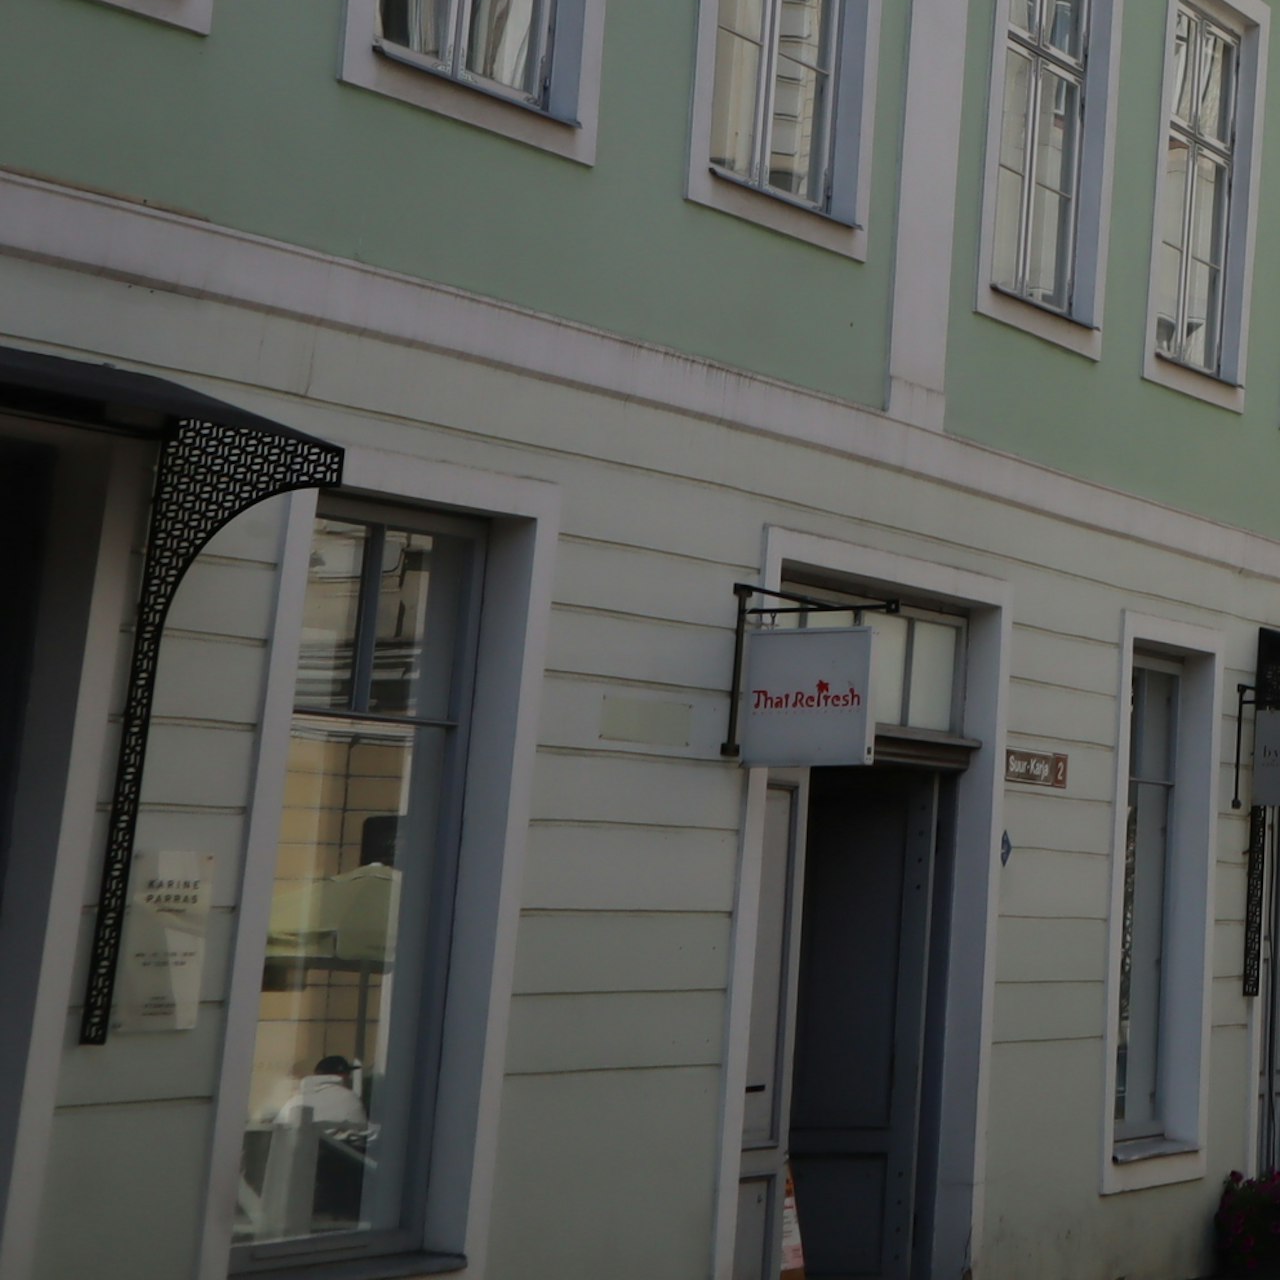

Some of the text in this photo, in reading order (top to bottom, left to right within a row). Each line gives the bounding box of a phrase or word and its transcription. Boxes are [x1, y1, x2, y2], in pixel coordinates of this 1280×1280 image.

[752, 684, 861, 709] Thai Refresh
[1008, 754, 1050, 782] Suur-Karja
[1057, 761, 1065, 780] 2
[147, 879, 201, 890] KARINE
[145, 894, 198, 904] PARRAS
